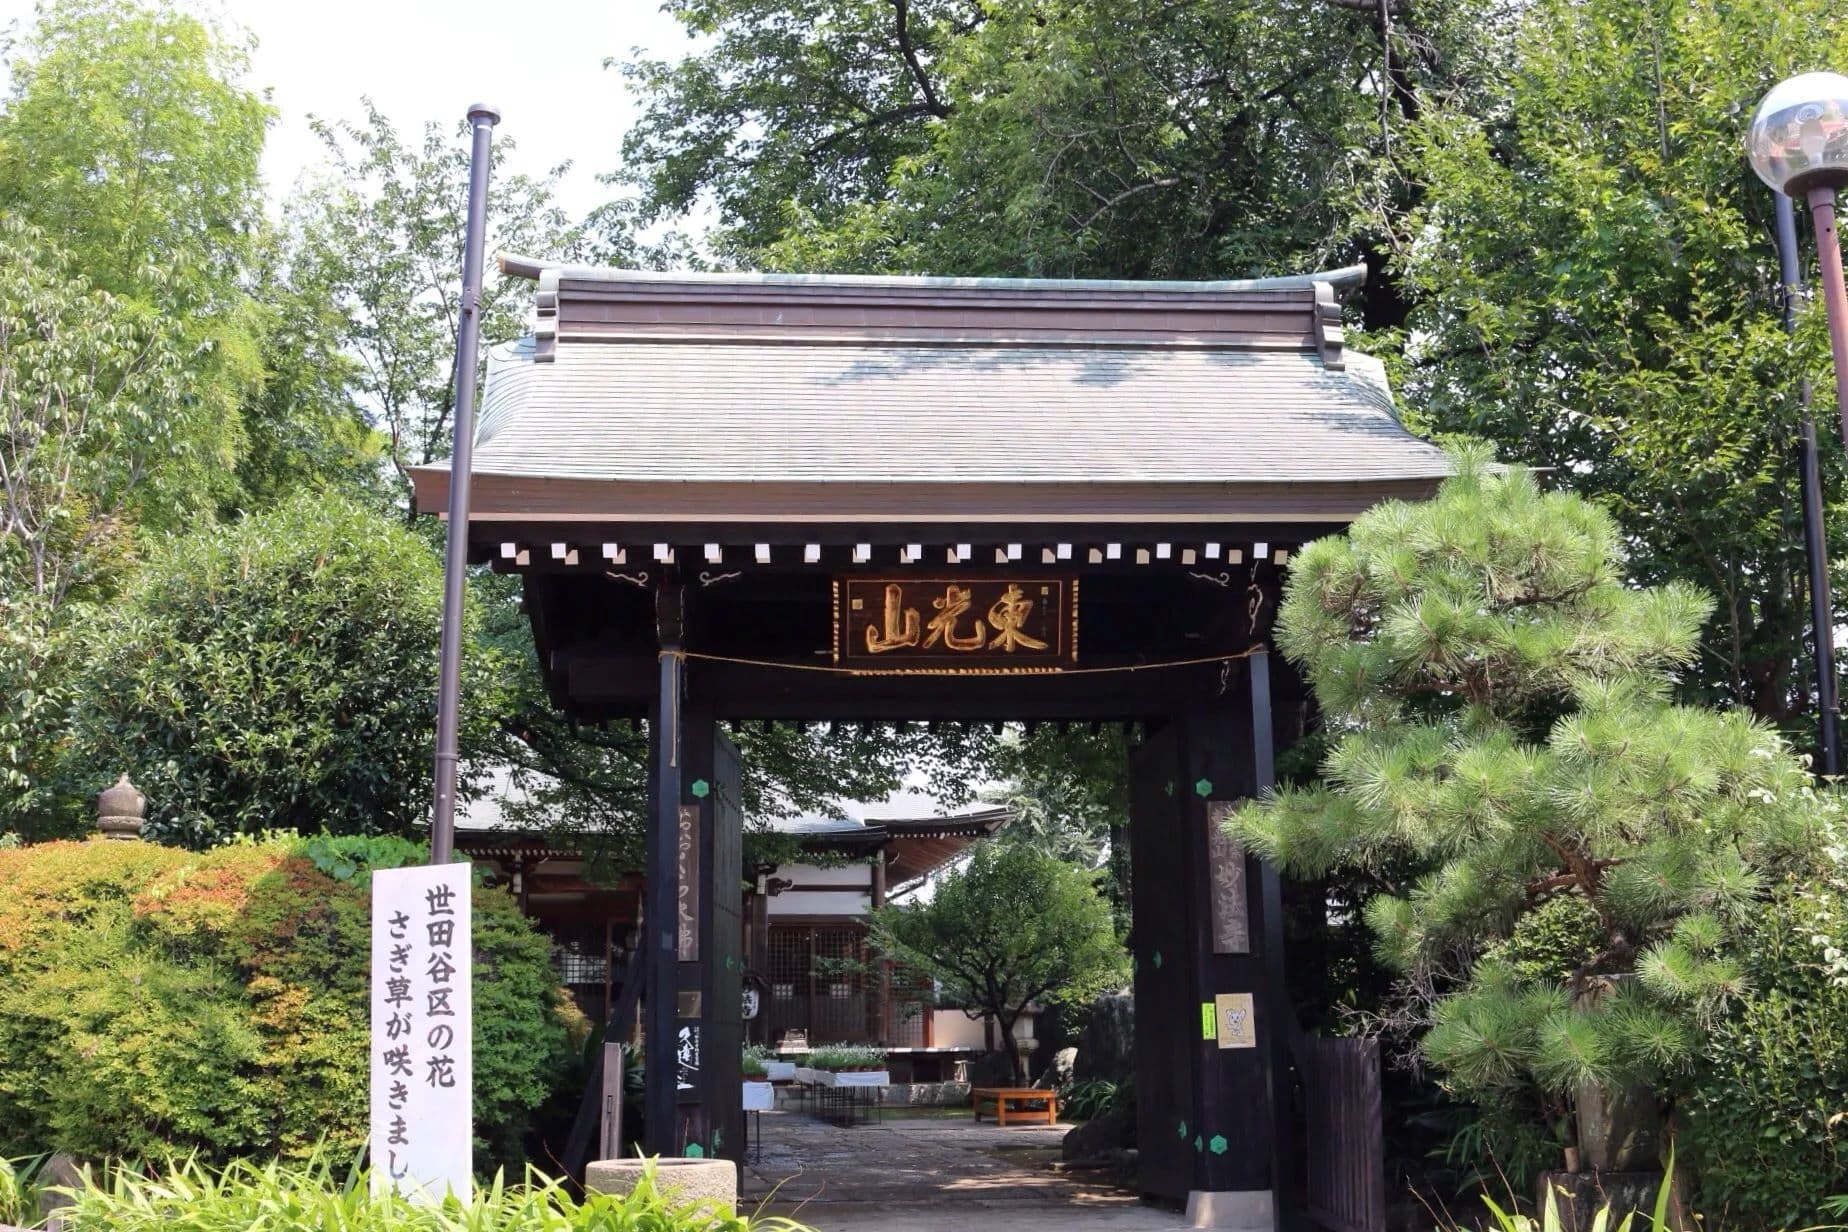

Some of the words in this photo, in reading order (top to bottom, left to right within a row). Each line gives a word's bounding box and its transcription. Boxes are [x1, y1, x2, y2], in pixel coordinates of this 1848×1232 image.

[865, 583, 1049, 653] 東光山
[383, 910, 413, 1199] さぎ草が咲きまし
[425, 883, 456, 1088] 世田谷区の花
